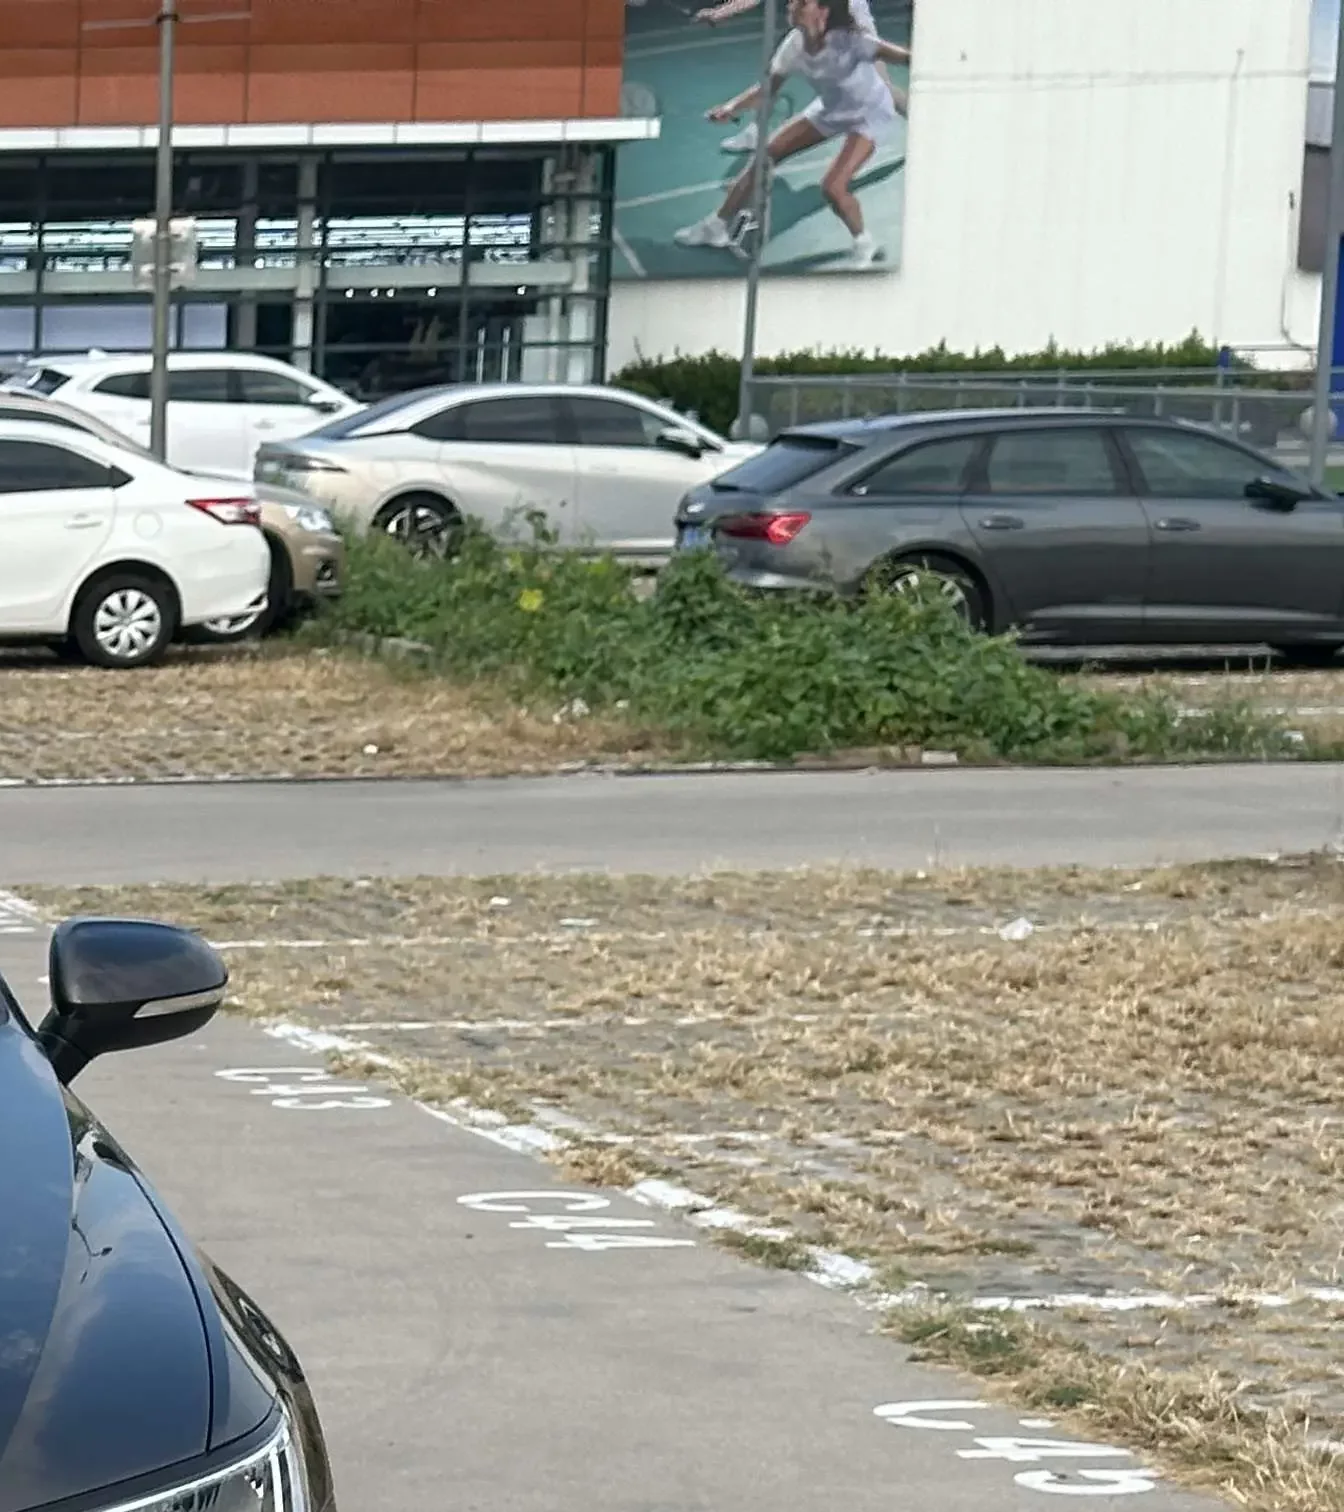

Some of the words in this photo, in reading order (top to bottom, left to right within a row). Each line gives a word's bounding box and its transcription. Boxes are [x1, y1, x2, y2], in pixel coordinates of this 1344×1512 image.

[213, 1066, 393, 1110] C43
[455, 1190, 697, 1253] C44
[872, 1399, 1163, 1496] C45
